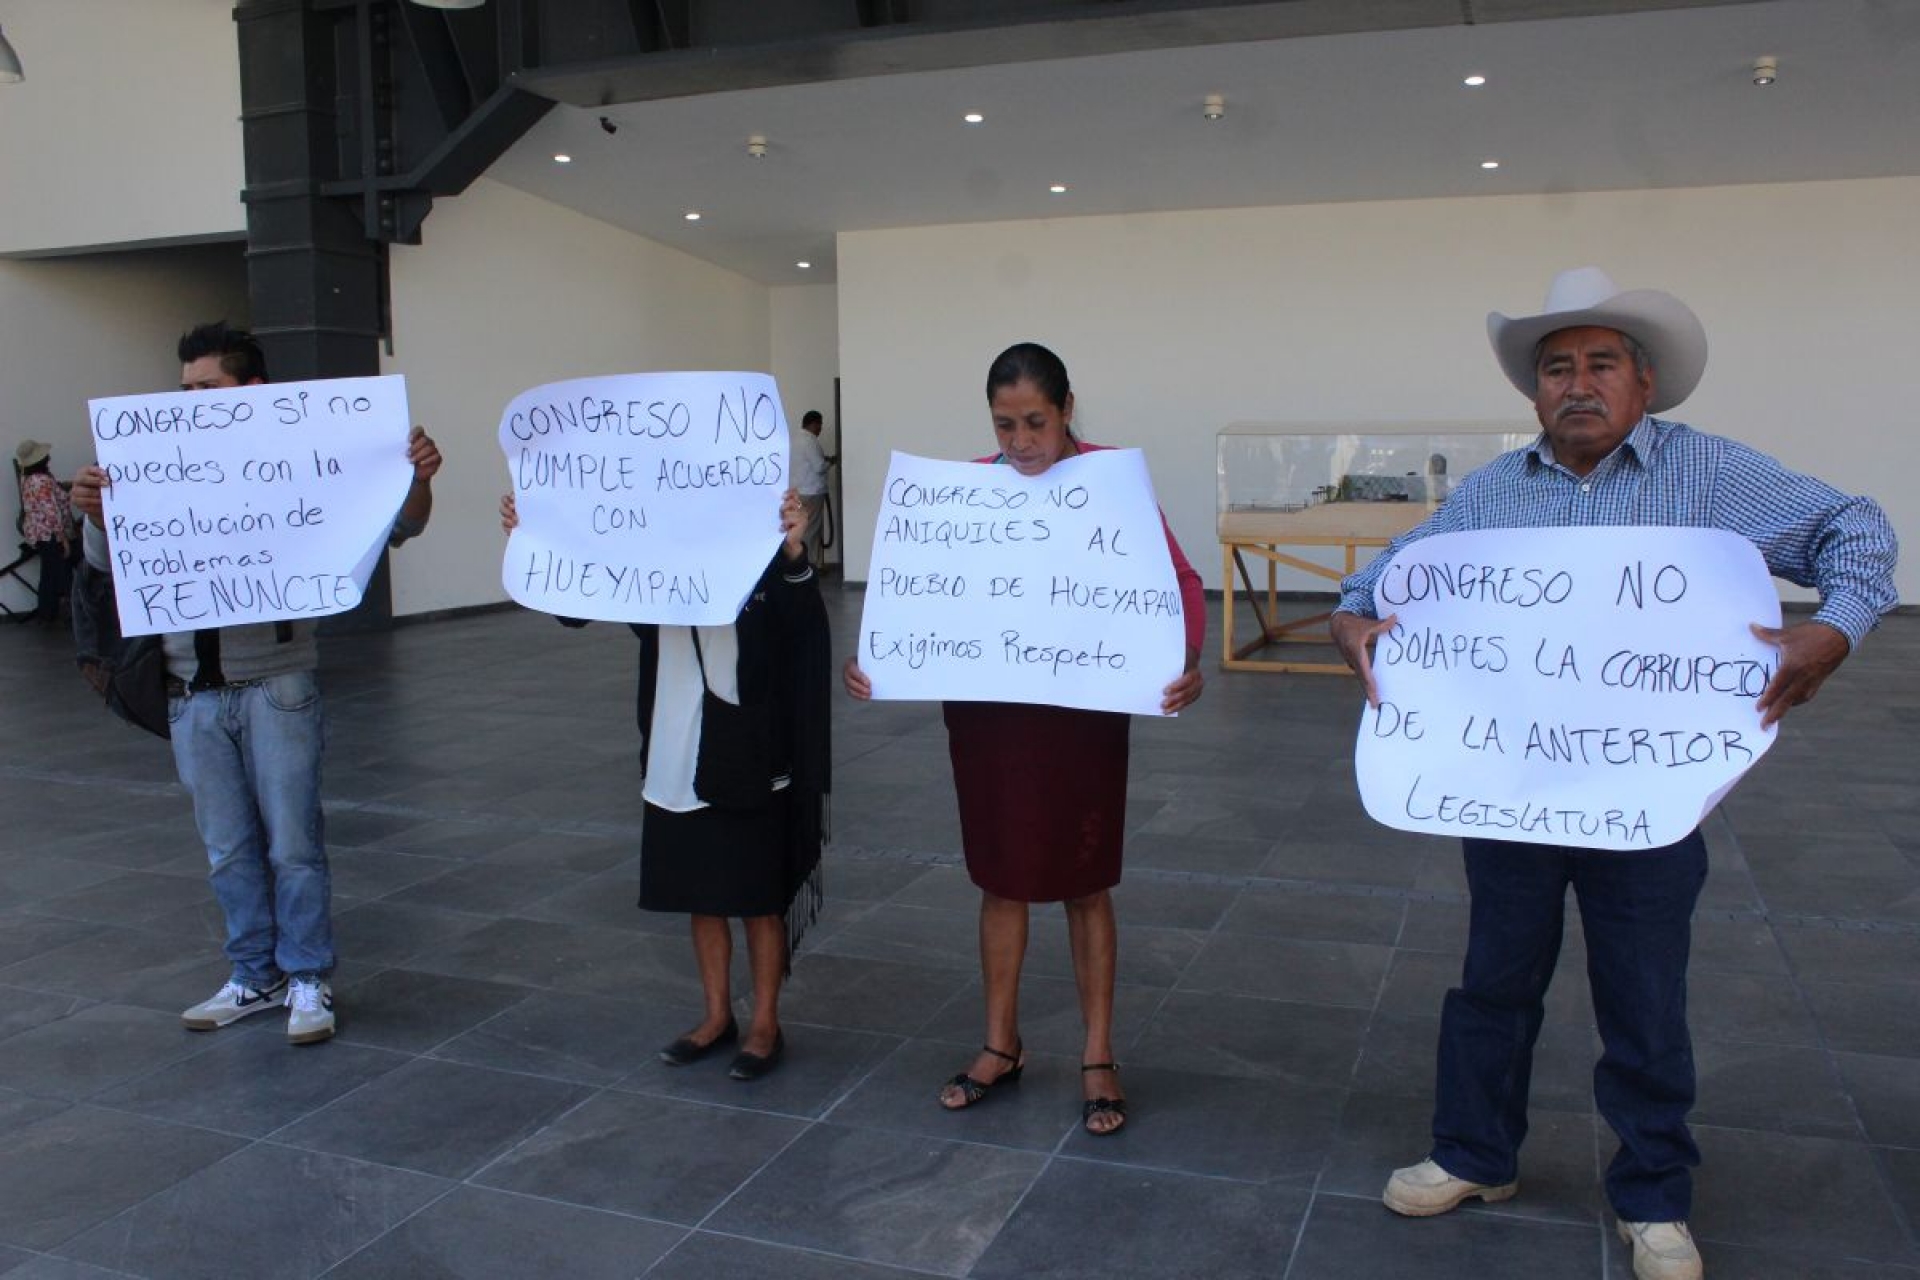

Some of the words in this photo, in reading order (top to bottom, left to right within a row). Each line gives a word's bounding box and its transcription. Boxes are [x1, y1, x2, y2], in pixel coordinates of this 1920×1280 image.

[96, 402, 253, 440] CONGRESO
[329, 397, 371, 415] no
[511, 396, 690, 440] CONGRESO
[715, 386, 776, 444] NO
[105, 447, 225, 500] puedes
[243, 460, 292, 483] con
[314, 450, 342, 477] la
[519, 448, 634, 492] CUMPLE
[657, 453, 782, 492] ACUERDOS
[889, 478, 1029, 509] CONGRESO
[1047, 485, 1088, 509] NO
[113, 502, 274, 541] Resolución
[287, 498, 323, 527] de
[593, 505, 647, 534] CON
[1087, 527, 1127, 556] AL
[118, 550, 273, 577] Problemas
[526, 550, 710, 604] HUEYAPAN
[1382, 562, 1573, 607] CONGRESO
[1616, 561, 1687, 609] NO
[134, 571, 354, 626] RENUNCIE
[880, 568, 965, 597] PUEBLO
[990, 577, 1024, 597] DE
[1050, 576, 1180, 618] HUEYAPAN
[870, 631, 982, 669] Exigimos
[1387, 623, 1508, 672] SOLAPES
[1535, 639, 1580, 681] LA
[1375, 701, 1424, 740] DE
[1462, 716, 1505, 754] LA
[1525, 722, 1753, 767] ANTERIOR
[1406, 774, 1652, 843] LEGISLATURA
